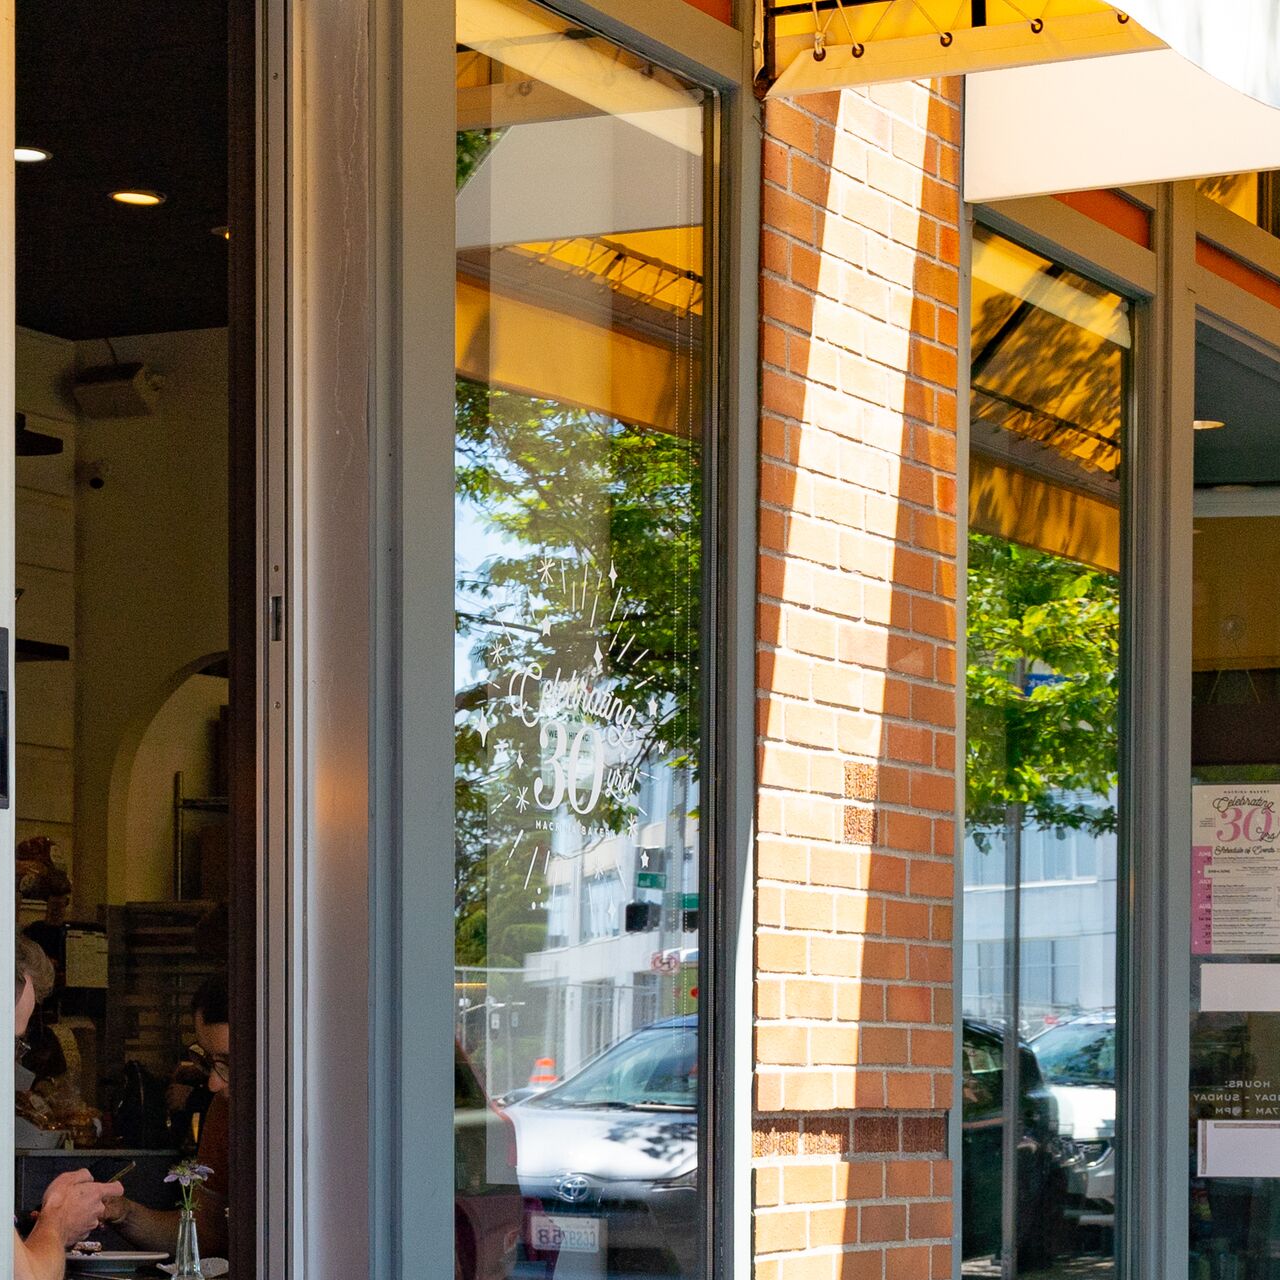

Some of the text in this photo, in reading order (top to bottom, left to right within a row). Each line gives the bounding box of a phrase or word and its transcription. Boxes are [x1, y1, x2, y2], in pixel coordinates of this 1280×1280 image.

[534, 720, 607, 814] 30
[1212, 796, 1276, 814] Celebrating
[1216, 807, 1273, 843] 30
